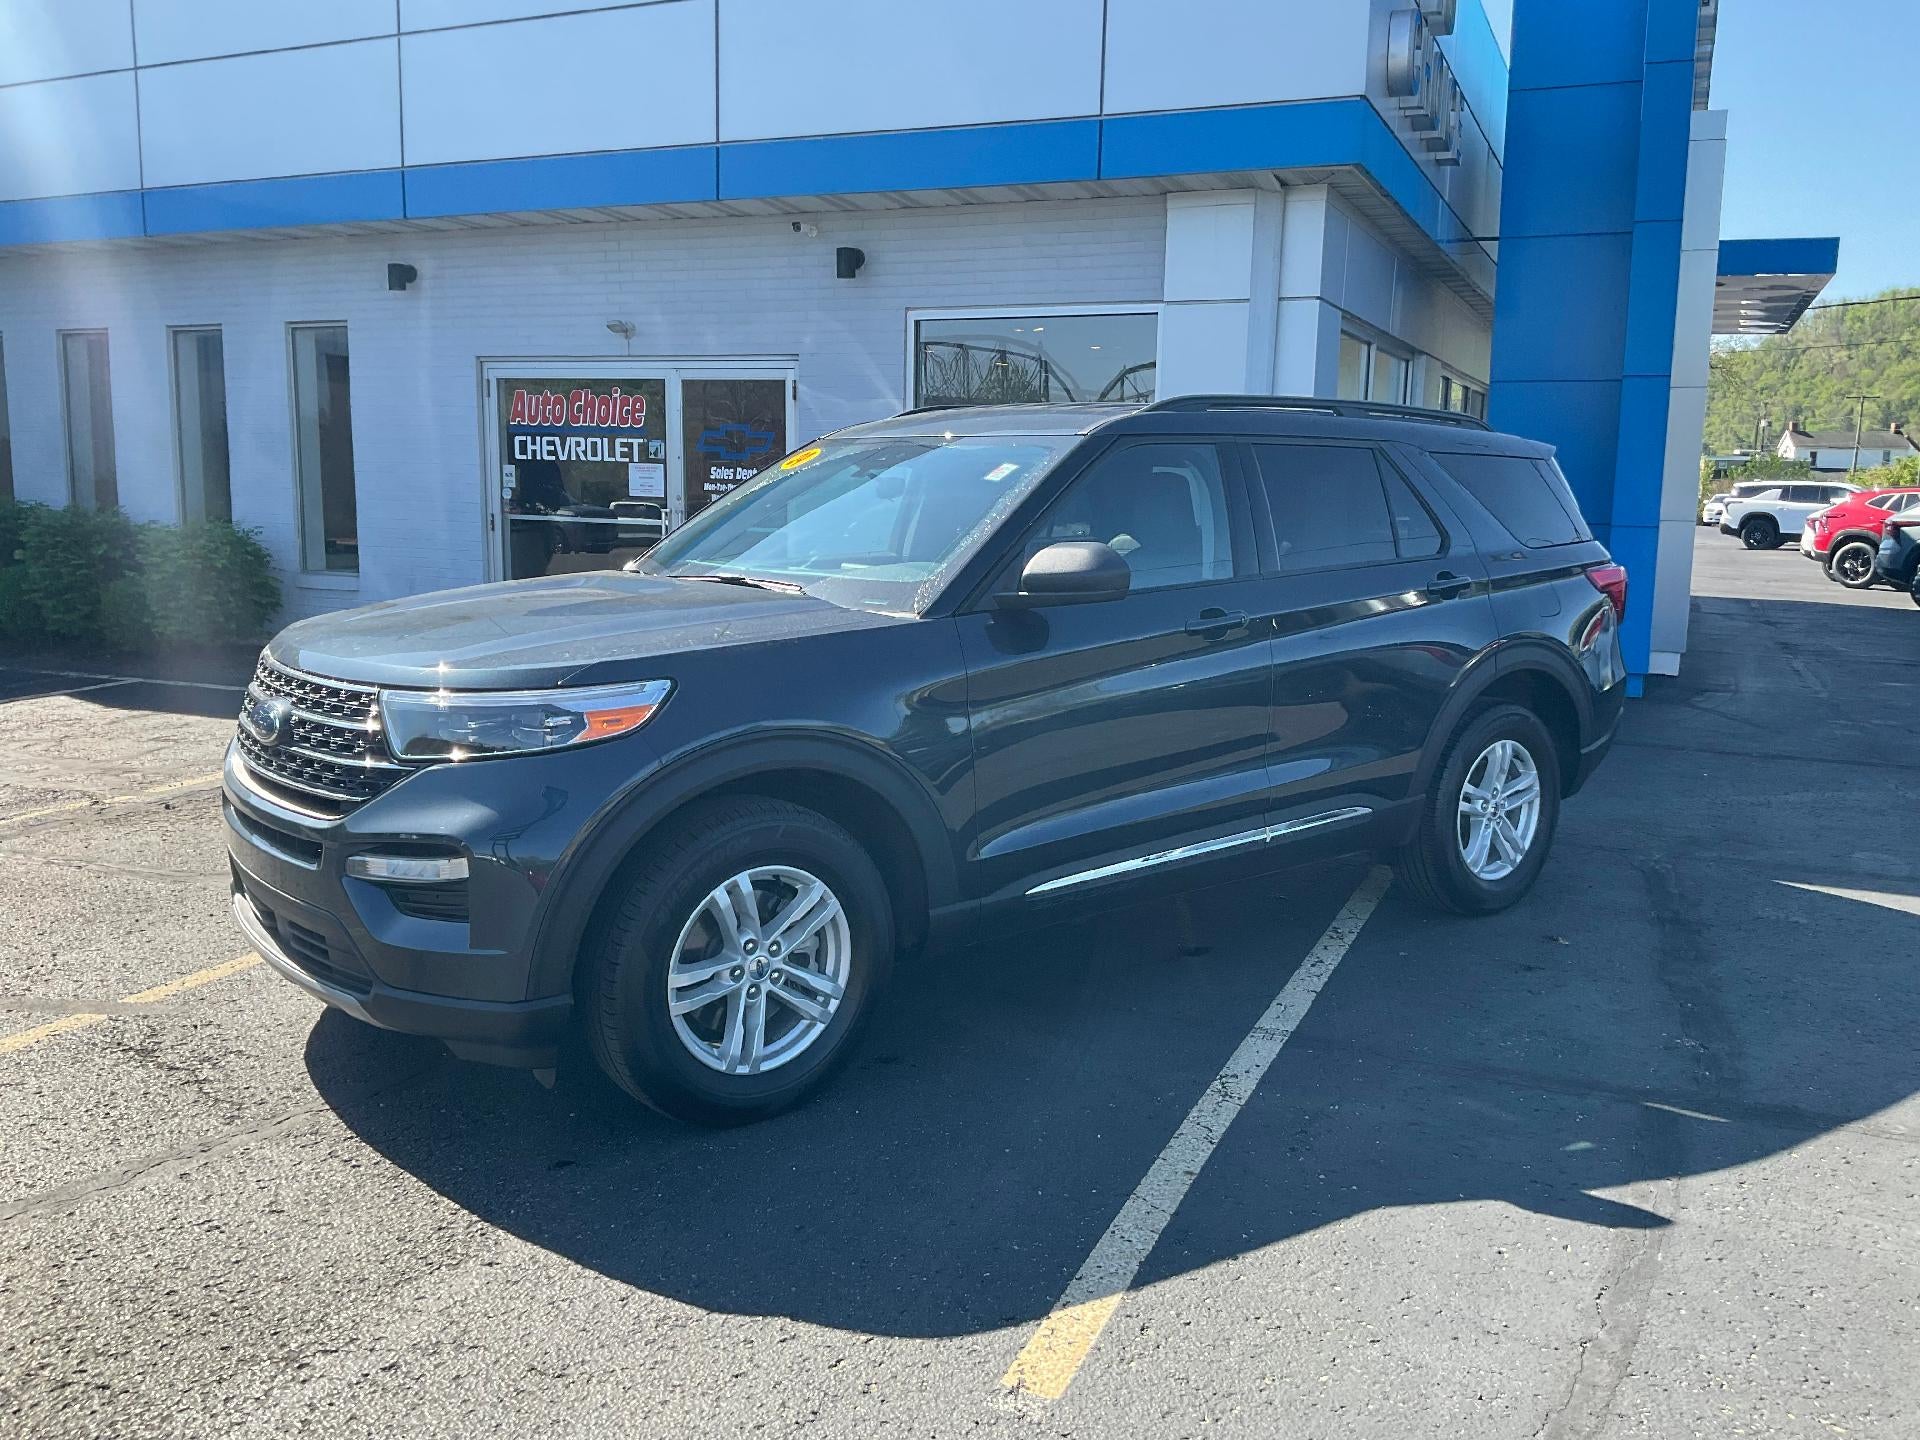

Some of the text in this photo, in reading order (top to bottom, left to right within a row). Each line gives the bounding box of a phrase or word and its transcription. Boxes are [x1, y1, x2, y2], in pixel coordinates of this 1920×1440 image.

[510, 387, 646, 427] Auto Choice
[514, 436, 644, 462] CHEVROLET
[710, 466, 734, 479] Sales
